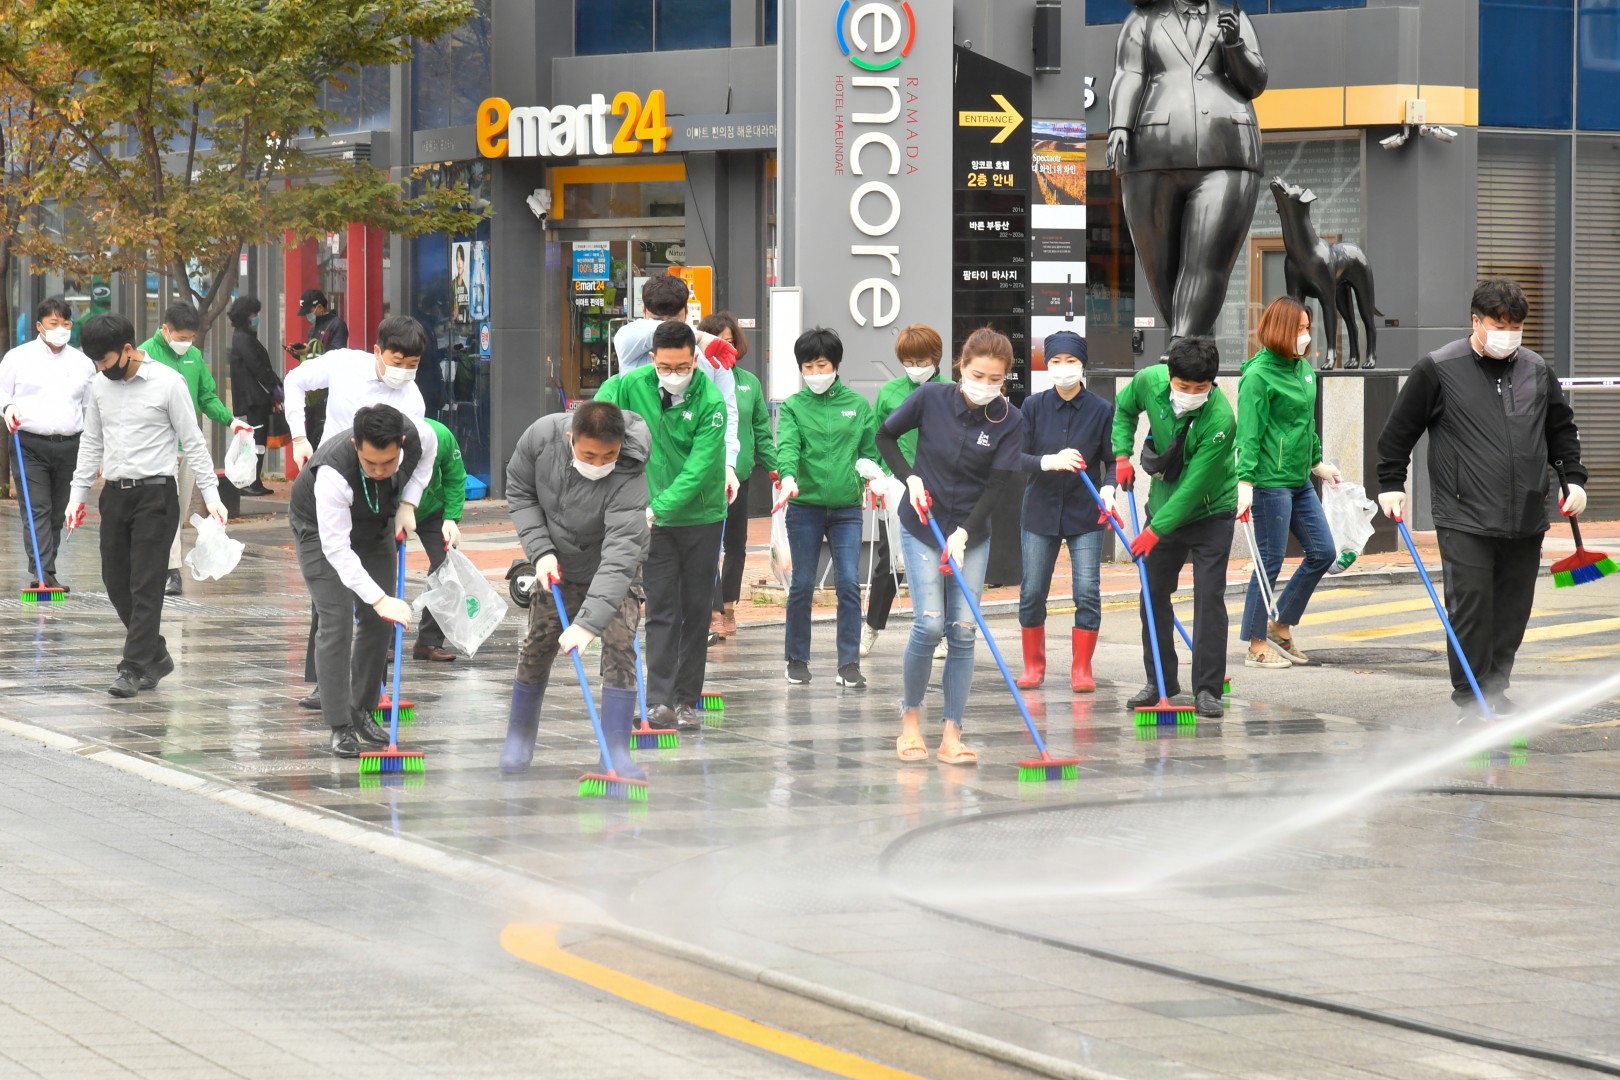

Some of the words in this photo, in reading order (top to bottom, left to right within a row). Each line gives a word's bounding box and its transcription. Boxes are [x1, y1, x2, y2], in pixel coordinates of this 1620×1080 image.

[834, 75, 844, 112] HOTEL
[476, 89, 672, 159] emart24
[906, 76, 919, 175] RAMADA
[964, 115, 1014, 124] ENTRANCE
[686, 126, 710, 140] 이마트
[711, 125, 735, 139] 편의점
[834, 115, 844, 176] HAEUNDAE
[849, 2, 902, 328] encore
[971, 160, 993, 170] 앙코르
[995, 160, 1010, 170] 호텔
[967, 172, 988, 187] 2층
[992, 173, 1014, 187] 안내
[969, 221, 985, 231] 바른
[986, 221, 1010, 231] 부동산
[962, 270, 988, 281] 팜타이
[991, 270, 1018, 281] 마사지
